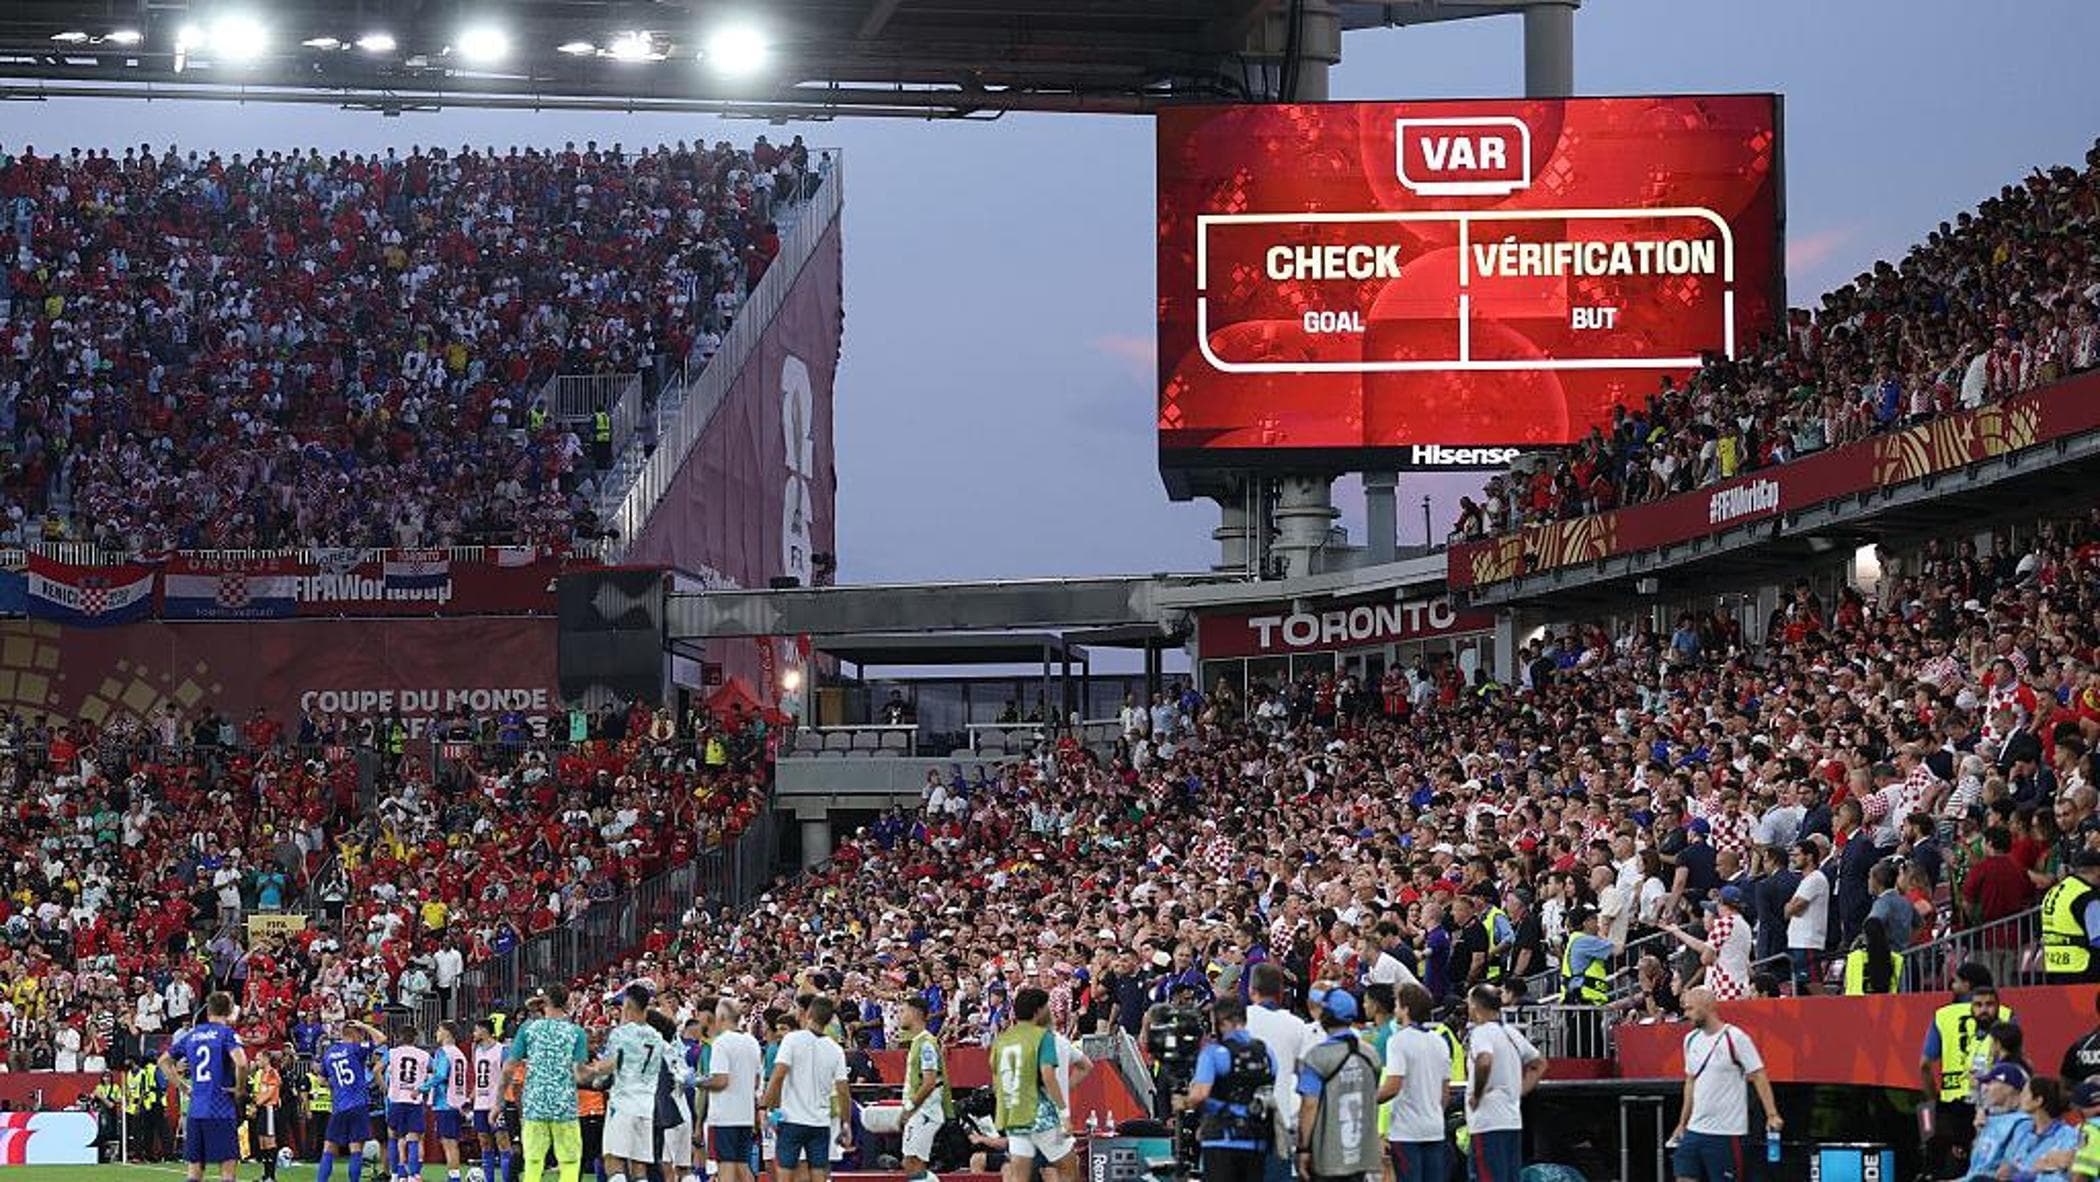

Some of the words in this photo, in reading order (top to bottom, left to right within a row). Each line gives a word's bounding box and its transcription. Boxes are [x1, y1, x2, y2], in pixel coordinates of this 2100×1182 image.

[1420, 136, 1507, 170] VAR
[1266, 245, 1401, 280] CHECK
[1474, 236, 1716, 277] VÉRIFICATION
[1303, 311, 1365, 333] GOAL
[1571, 307, 1617, 329] BUT
[1248, 595, 1456, 648] TORONTO
[301, 689, 394, 713] COUPE
[401, 689, 438, 712] DU
[447, 687, 547, 712] MONDE
[196, 1045, 212, 1082] 2
[331, 1059, 355, 1087] 15
[641, 1043, 655, 1074] 7
